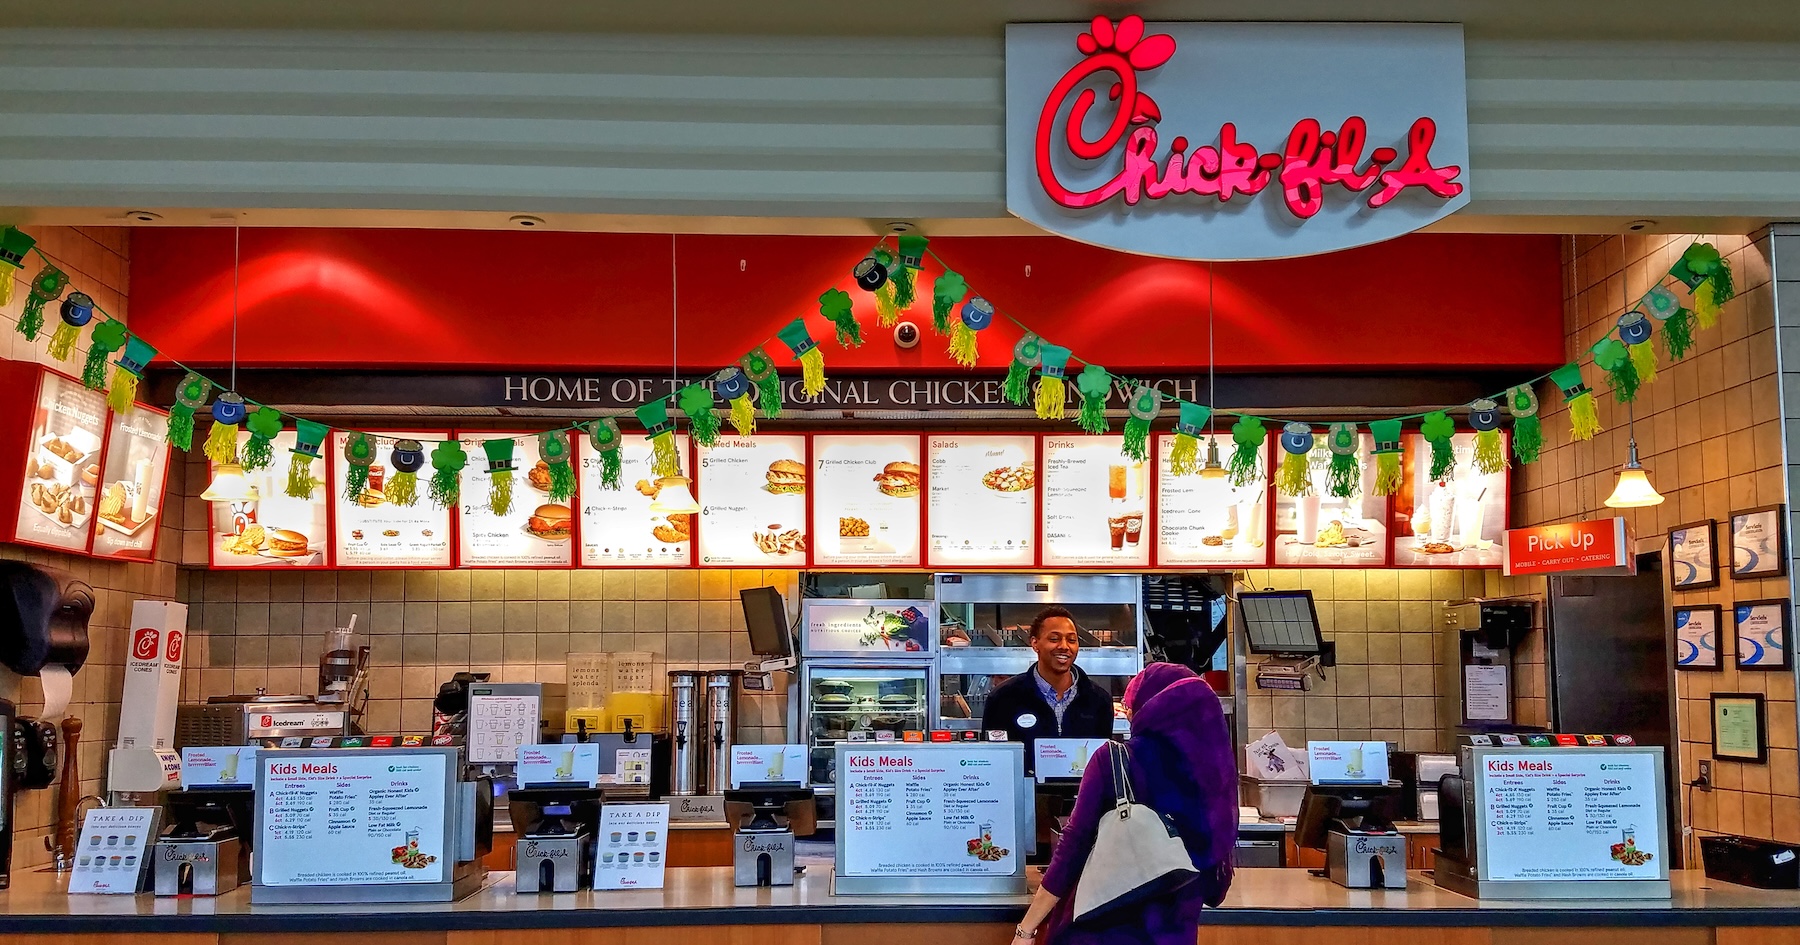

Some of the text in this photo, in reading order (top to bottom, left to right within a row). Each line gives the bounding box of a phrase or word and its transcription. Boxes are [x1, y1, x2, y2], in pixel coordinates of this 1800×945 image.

[1036, 50, 1463, 218] Chick-fil-A
[504, 377, 600, 401] HOME
[611, 378, 652, 401] OF
[888, 380, 1008, 404] CHICKE
[43, 397, 73, 417] Chicken
[72, 406, 100, 425] Nuggets
[120, 422, 138, 435] Frosted
[138, 427, 162, 442] Lemonade
[583, 459, 589, 468] 3
[702, 458, 708, 467] 5
[819, 460, 824, 469] 7
[465, 506, 471, 514] 2
[584, 506, 591, 515] 4
[703, 506, 709, 515] 6
[33, 524, 51, 535] Equally
[114, 538, 124, 546] down
[125, 539, 134, 547] and
[134, 540, 143, 548] chill
[1528, 530, 1594, 552] Pick Up
[850, 756, 913, 766] Kids Meals
[1488, 760, 1553, 771] Kids Meals
[270, 763, 338, 774] Kids Meals
[744, 836, 785, 852] Chick-fil-A
